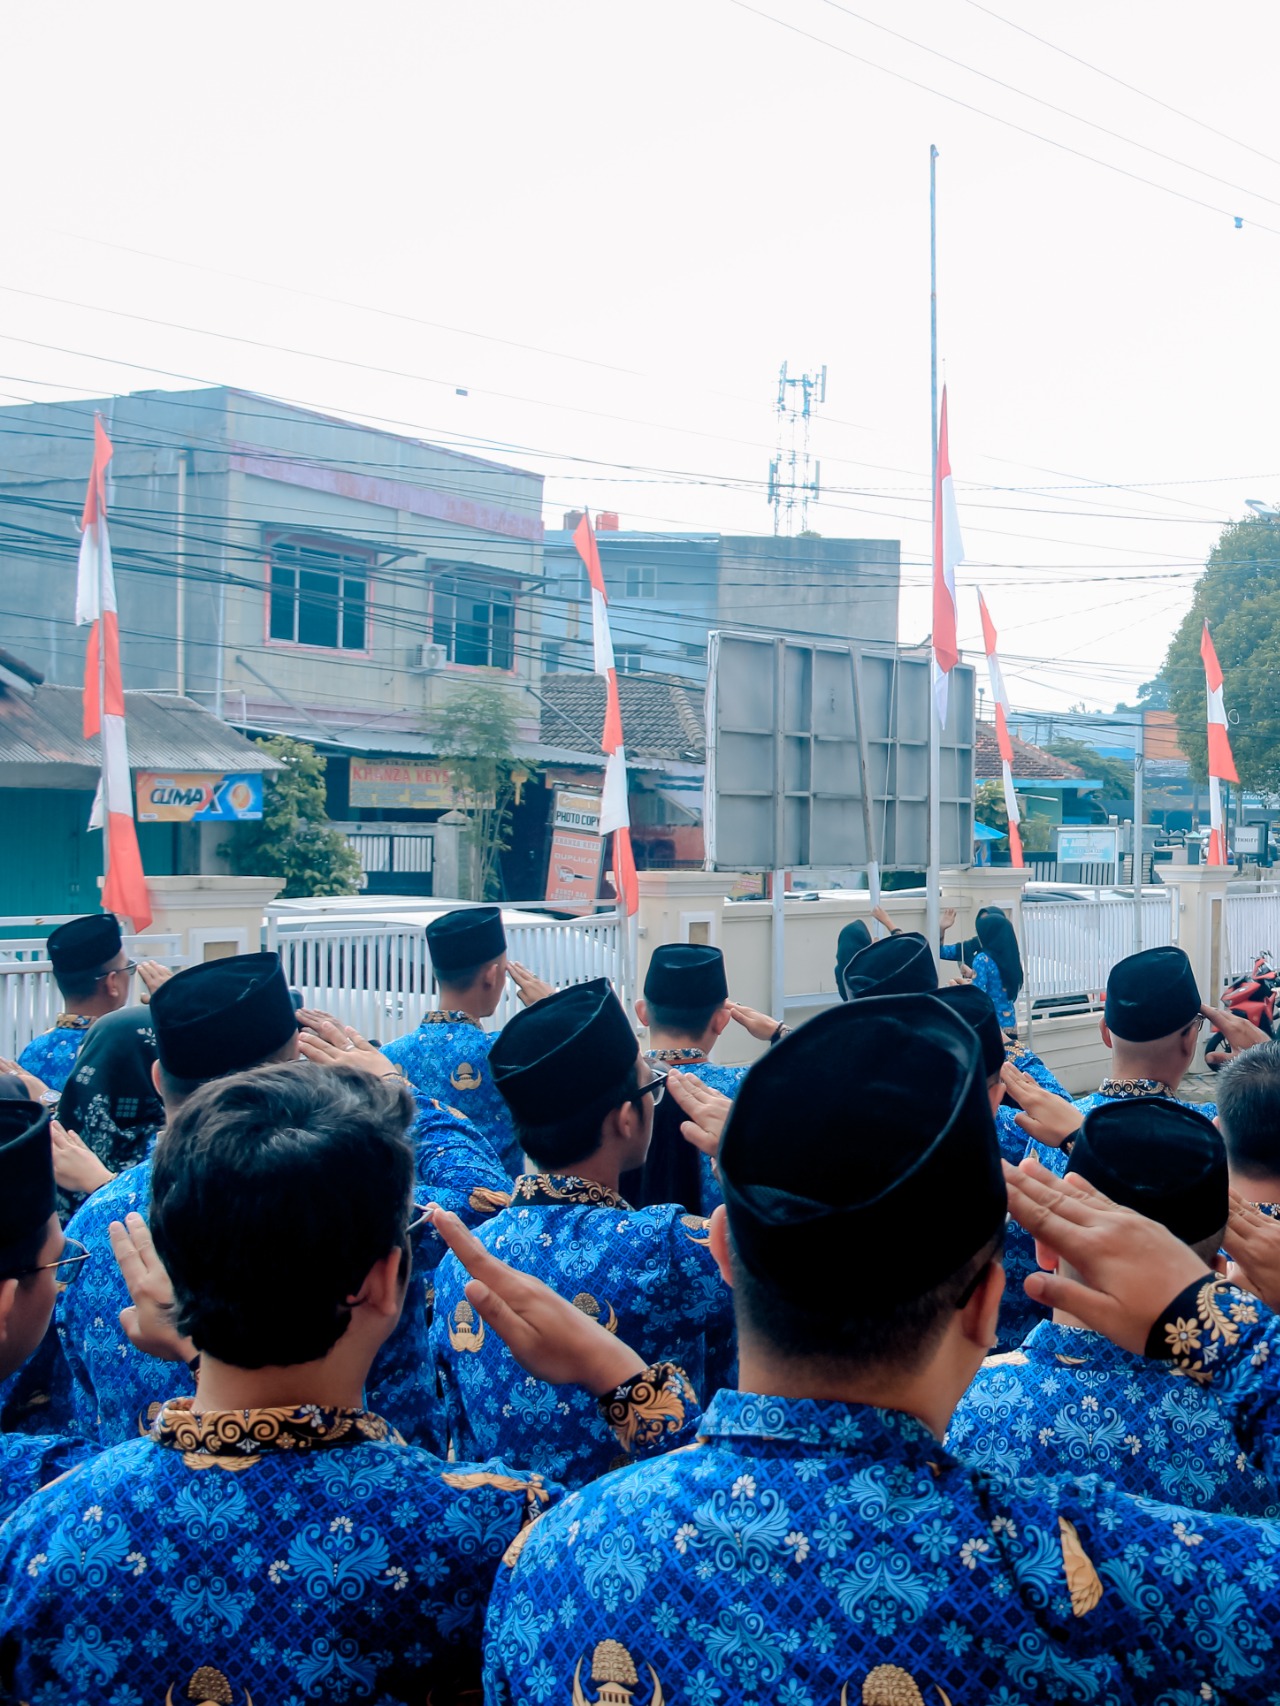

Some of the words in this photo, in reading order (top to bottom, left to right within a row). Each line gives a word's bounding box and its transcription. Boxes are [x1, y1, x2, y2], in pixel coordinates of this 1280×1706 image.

[352, 766, 411, 782] KHANZA
[415, 768, 450, 783] KEYS
[150, 780, 229, 814] CLIMAX
[556, 811, 580, 824] PHOTO
[581, 814, 600, 828] COPY
[554, 853, 597, 864] DUPLIKAT
